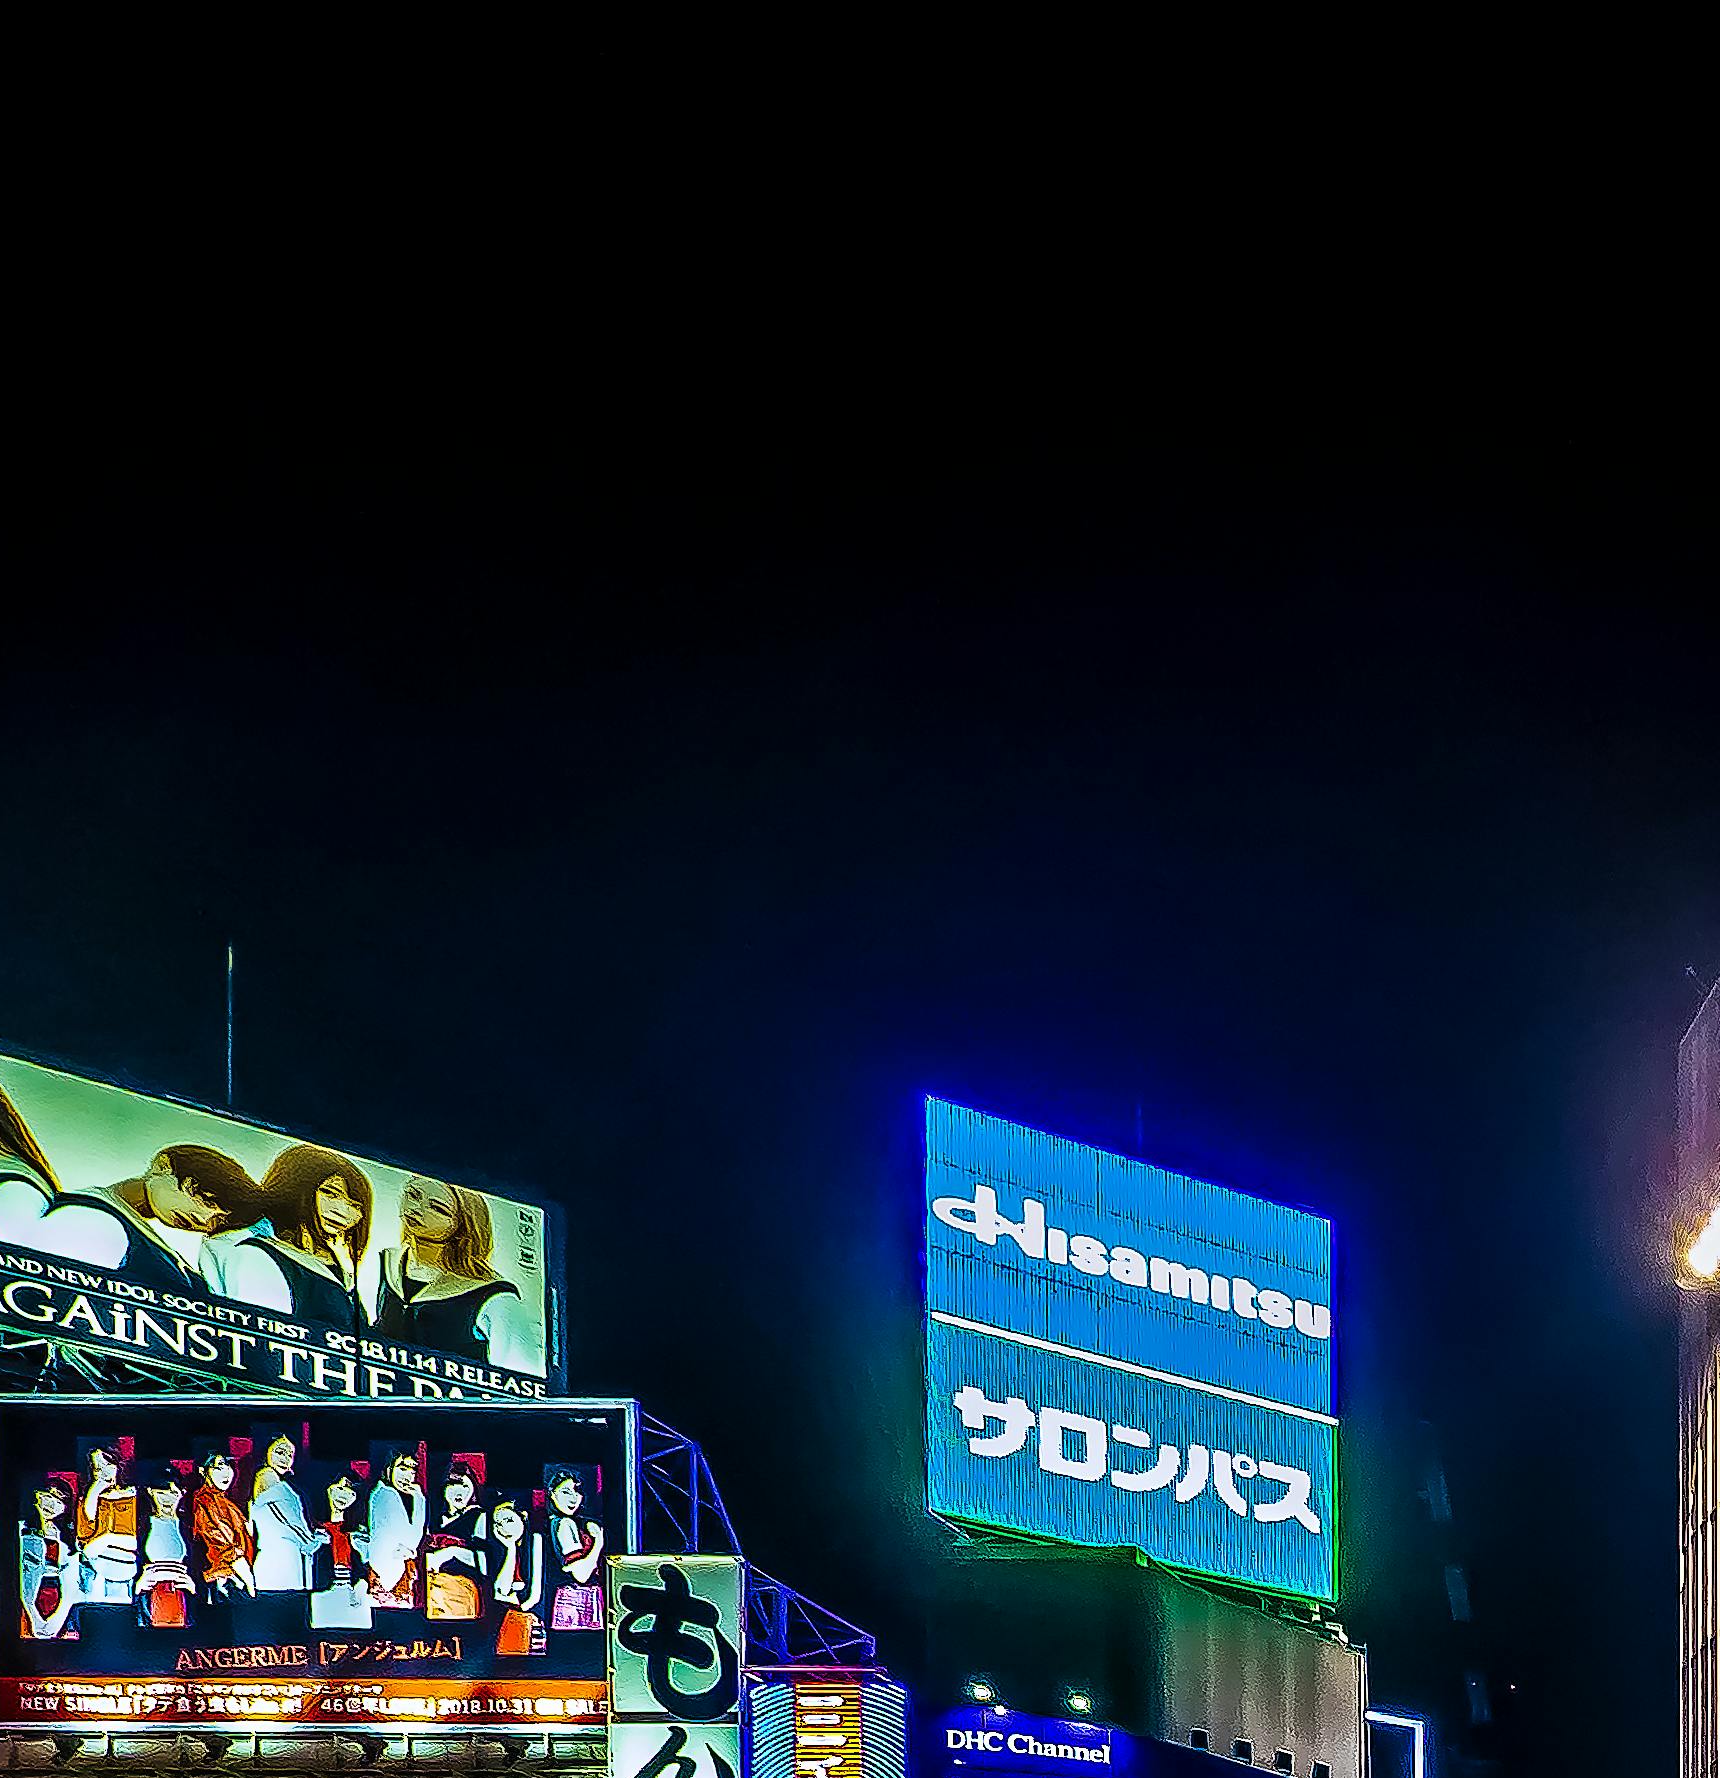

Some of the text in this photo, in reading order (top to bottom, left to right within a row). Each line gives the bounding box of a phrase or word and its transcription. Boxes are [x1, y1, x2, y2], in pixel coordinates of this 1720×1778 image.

[932, 1184, 1331, 1340] Hisamitsu
[47, 1265, 103, 1289] NEW
[108, 1280, 158, 1304] IDOL
[163, 1293, 252, 1326] SOCIETY
[257, 1317, 310, 1341] FIRST
[444, 1359, 547, 1398] RELEASE
[953, 1384, 1322, 1536] サロンパス
[176, 1645, 309, 1671] ANGERME
[946, 1729, 1112, 1764] DHC Channel
